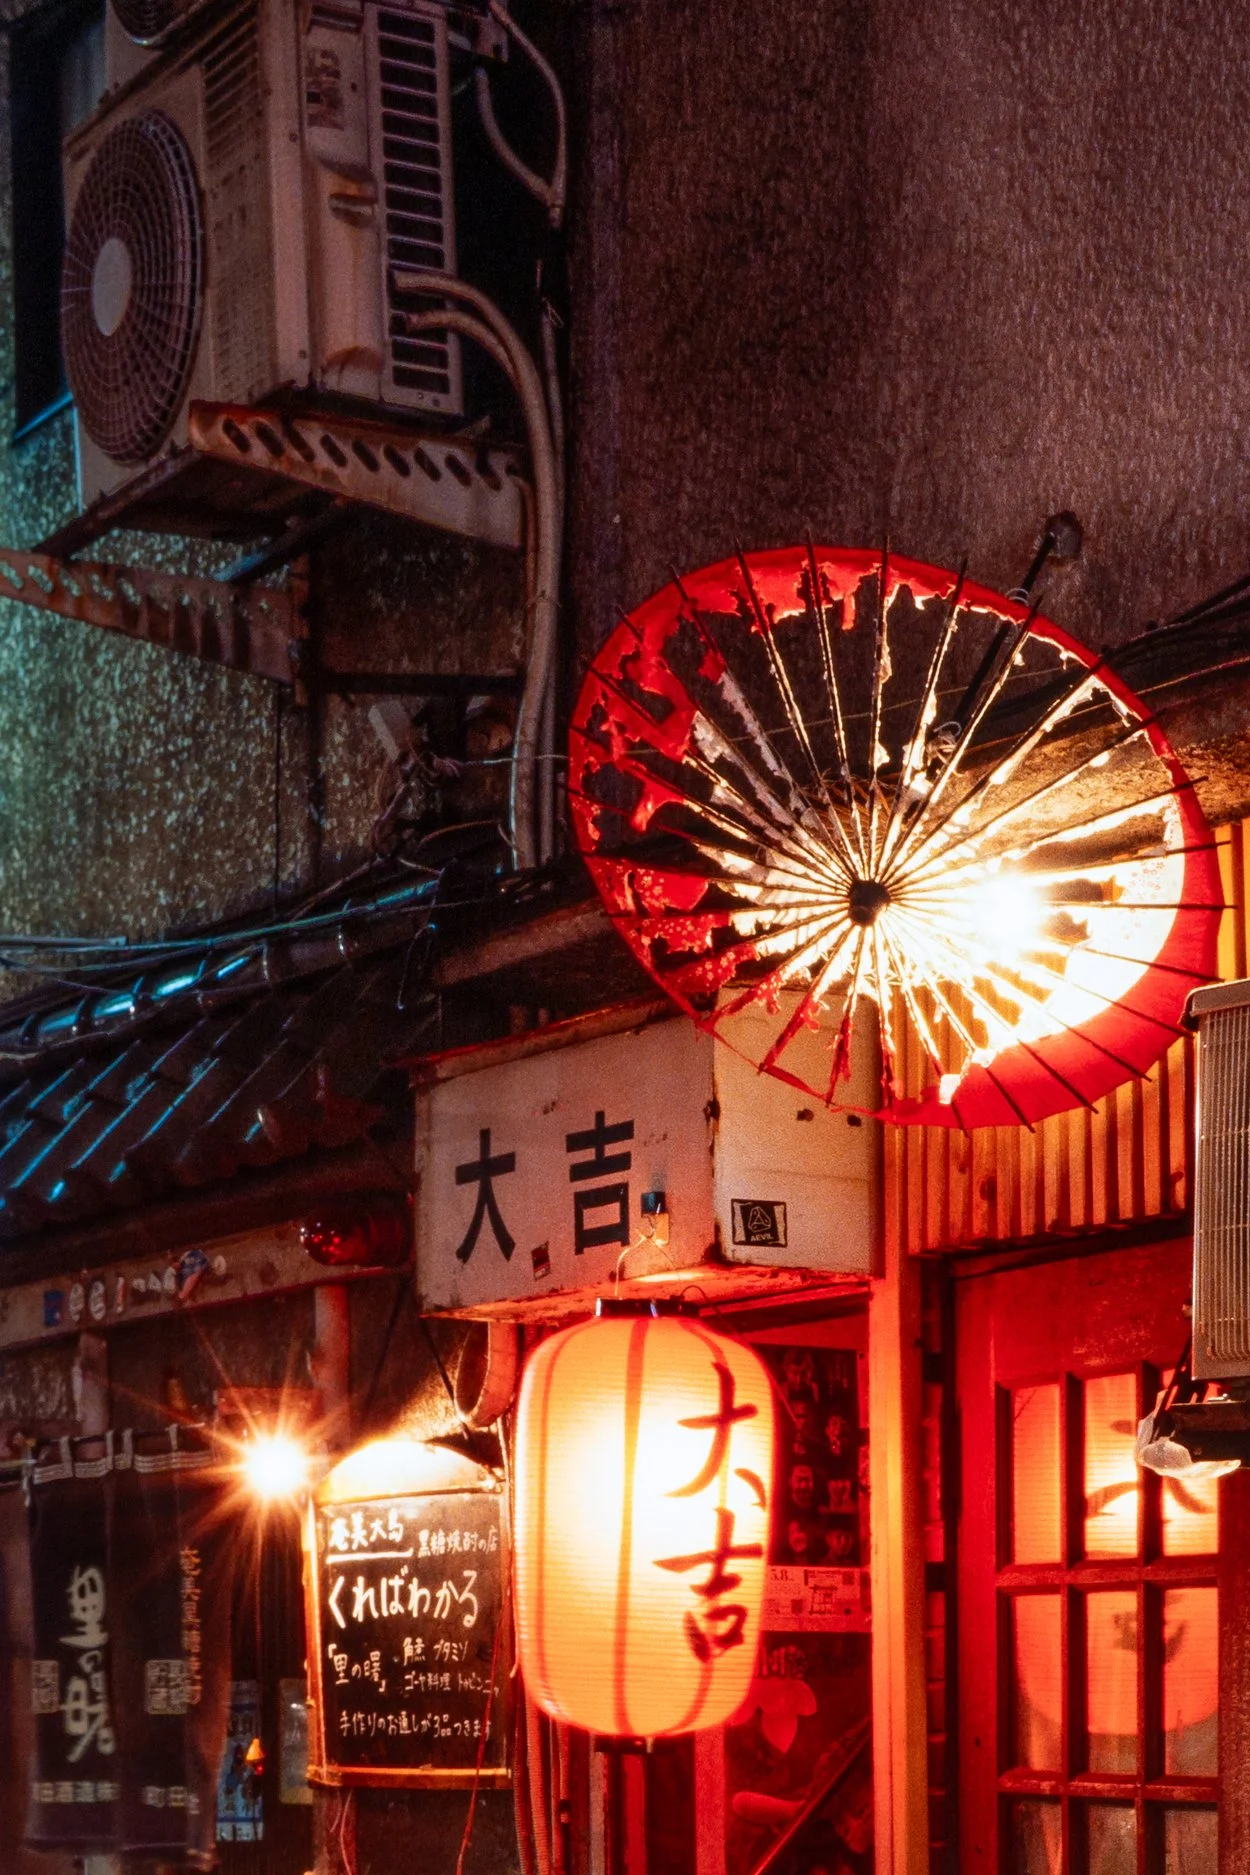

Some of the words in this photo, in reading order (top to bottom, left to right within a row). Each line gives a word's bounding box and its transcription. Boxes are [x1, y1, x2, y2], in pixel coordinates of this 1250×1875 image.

[455, 1110, 635, 1265] 大吉
[418, 1525, 499, 1558] 黒糖焼酎の店
[651, 1361, 766, 1663] 大吉
[328, 1565, 478, 1629] くればわかる
